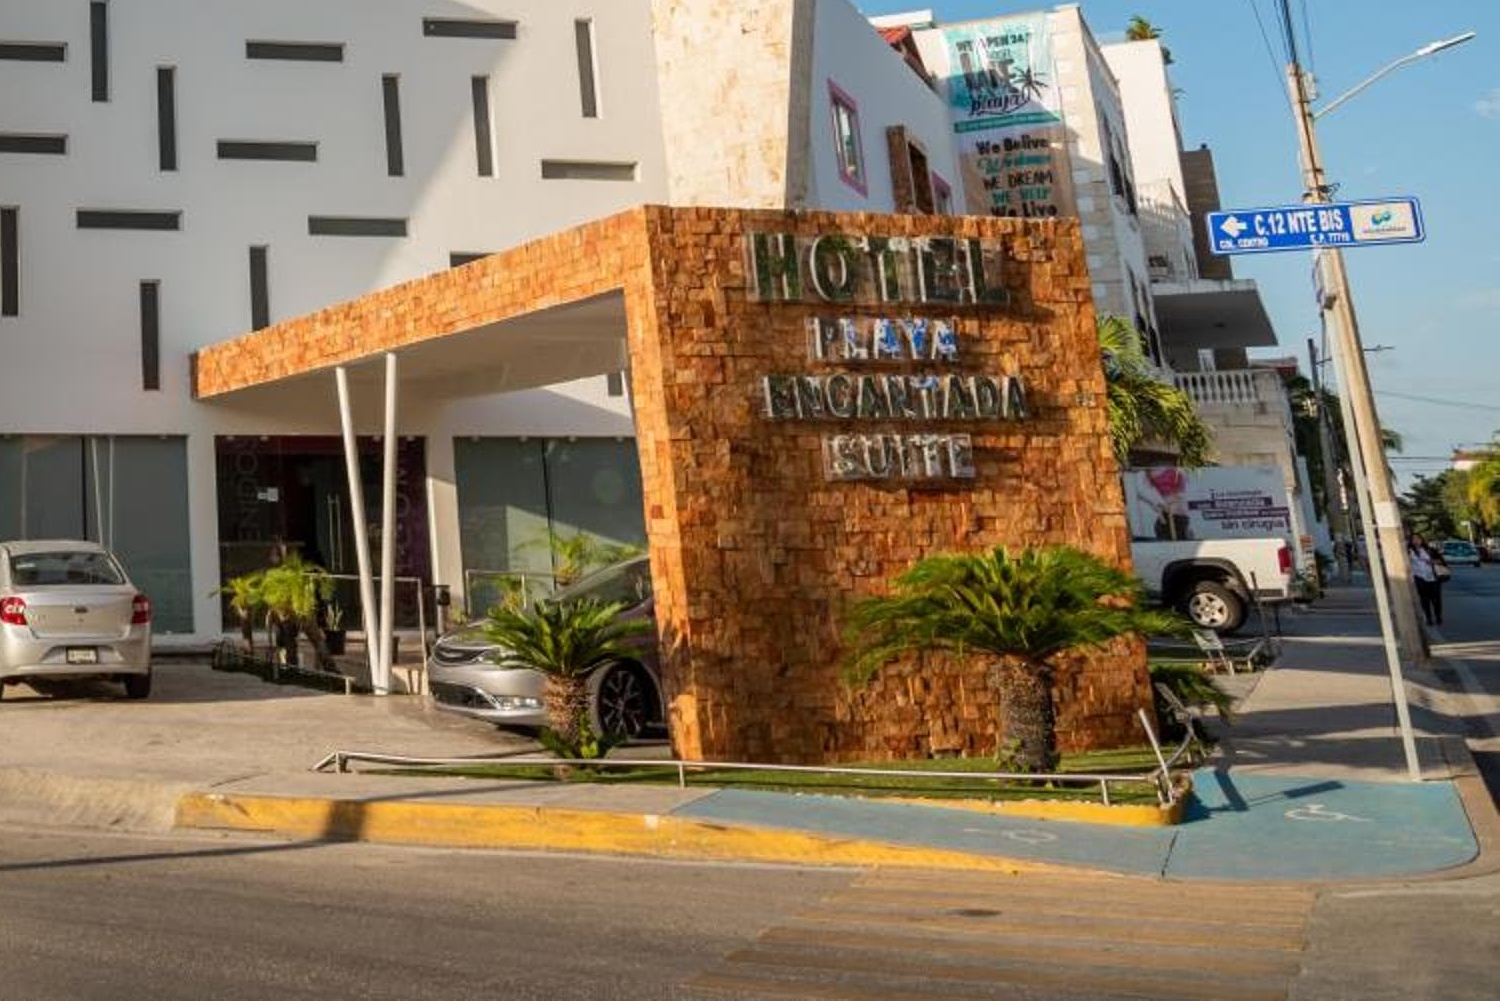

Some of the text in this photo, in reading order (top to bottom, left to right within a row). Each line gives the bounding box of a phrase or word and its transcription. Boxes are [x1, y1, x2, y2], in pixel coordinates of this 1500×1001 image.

[1254, 207, 1344, 235] C.12 NTE BIS
[750, 232, 1011, 303] HOTEL
[810, 317, 960, 361] PLAYA
[762, 374, 1029, 419] ENCANTADA
[826, 433, 975, 479] SUITE
